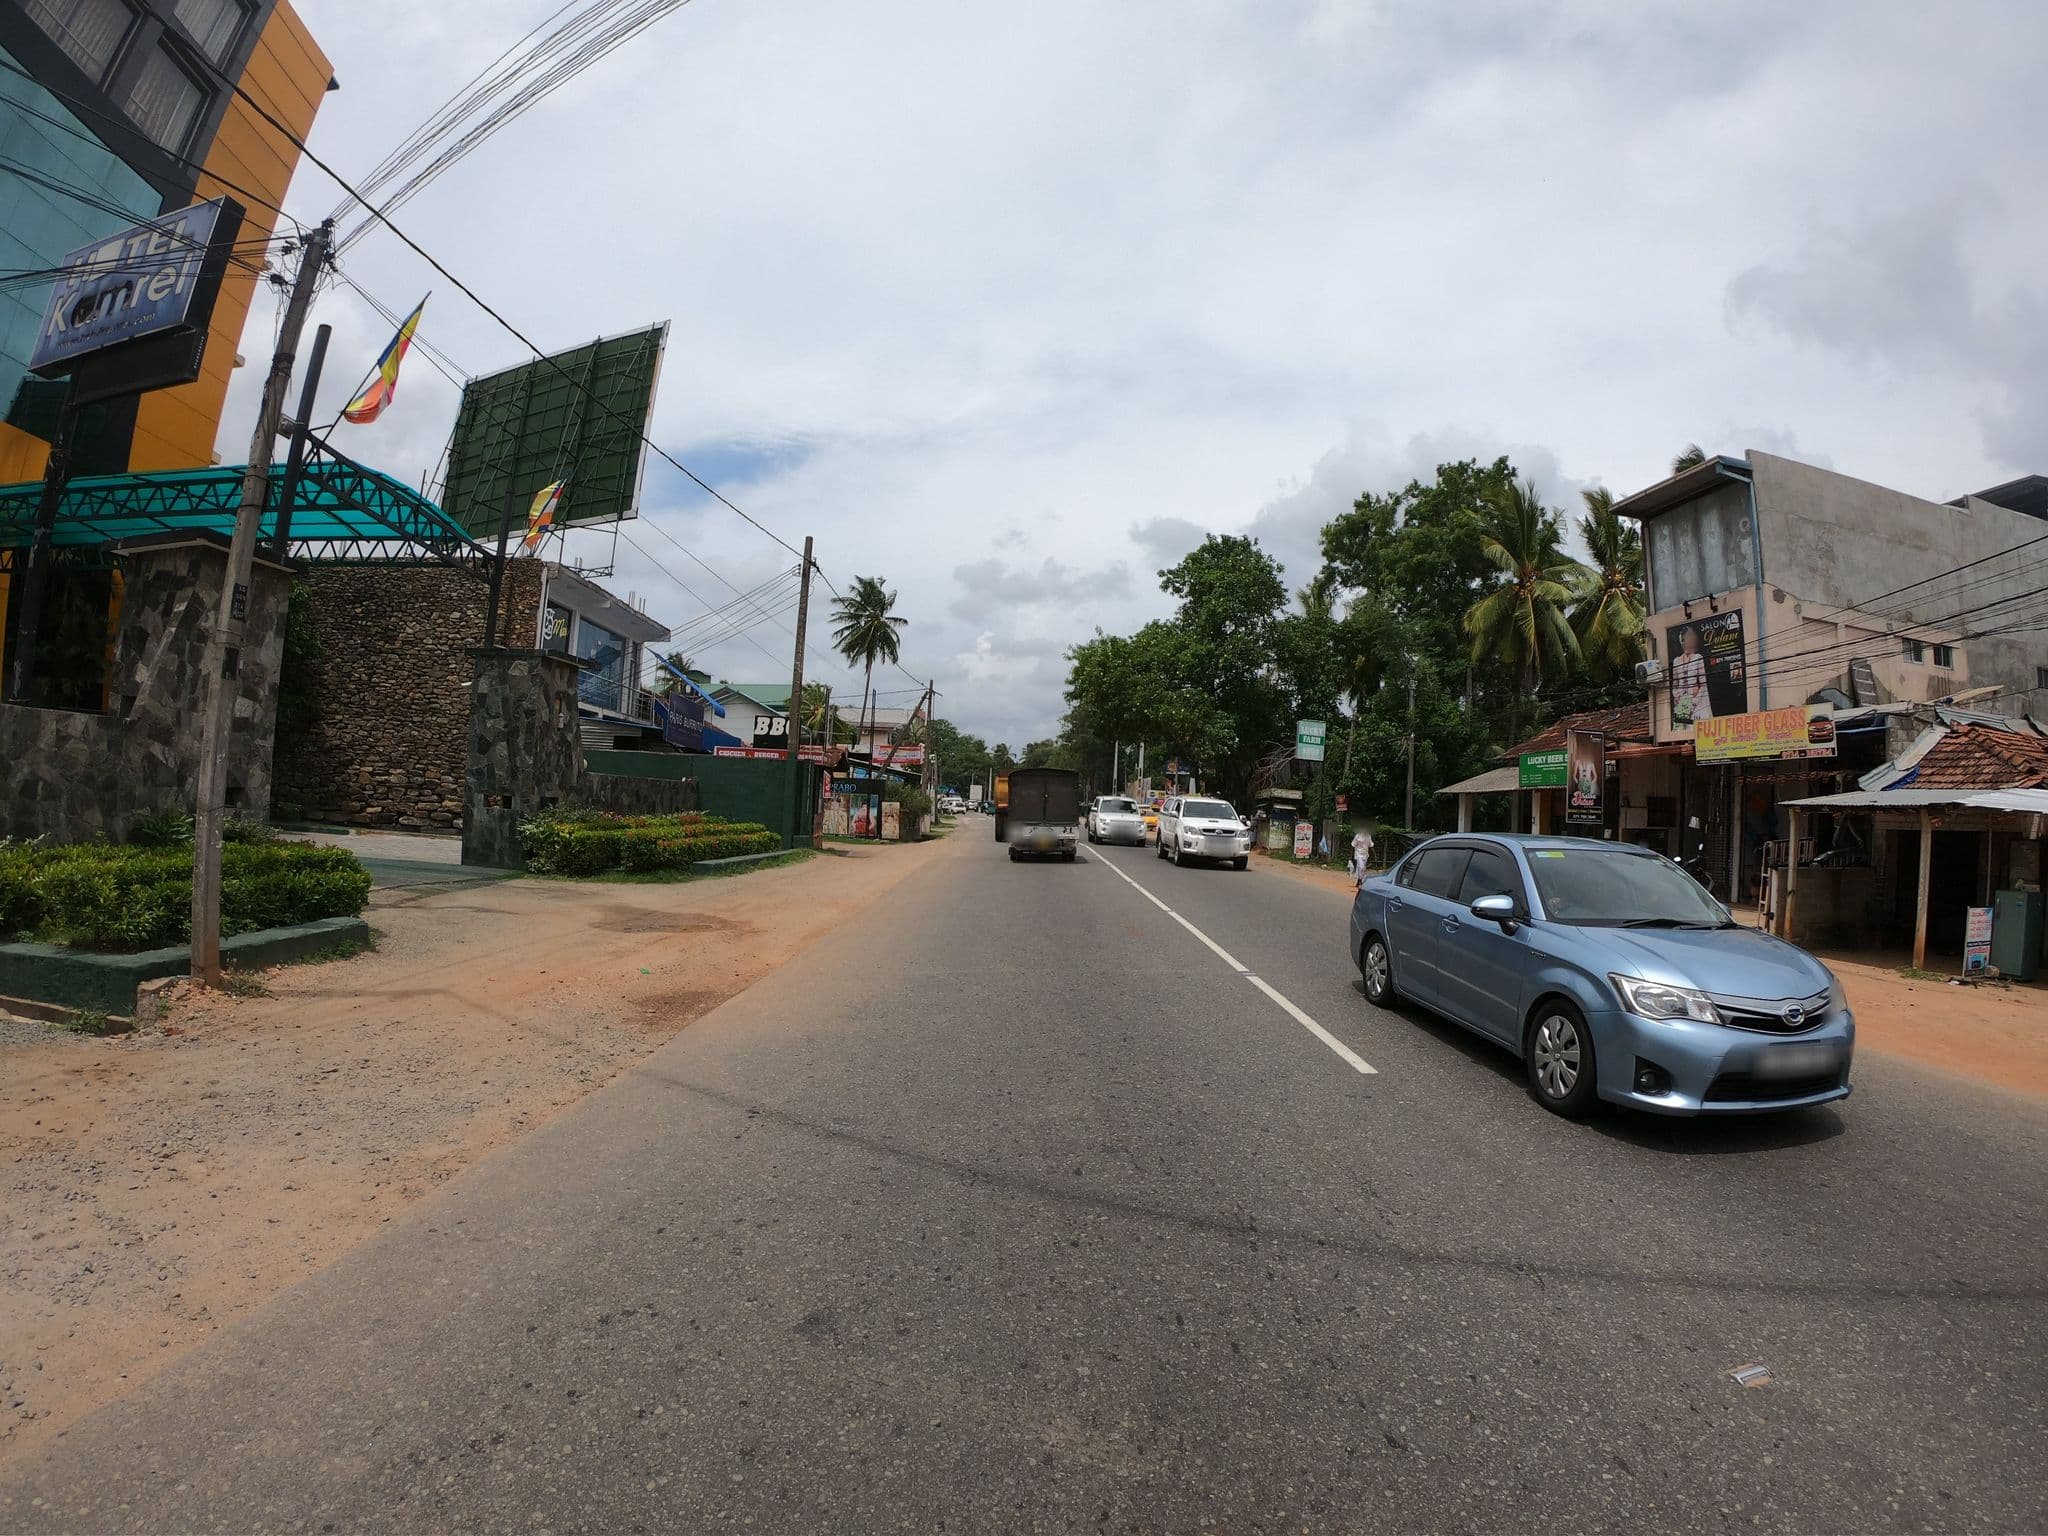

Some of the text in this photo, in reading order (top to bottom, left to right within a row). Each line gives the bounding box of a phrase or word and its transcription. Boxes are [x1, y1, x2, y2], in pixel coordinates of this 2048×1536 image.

[1701, 619, 1725, 632] SALON
[1696, 708, 1806, 738] FUJI FIBER GLASS
[1528, 755, 1546, 765] LUCKY
[1547, 754, 1563, 764] BEER
